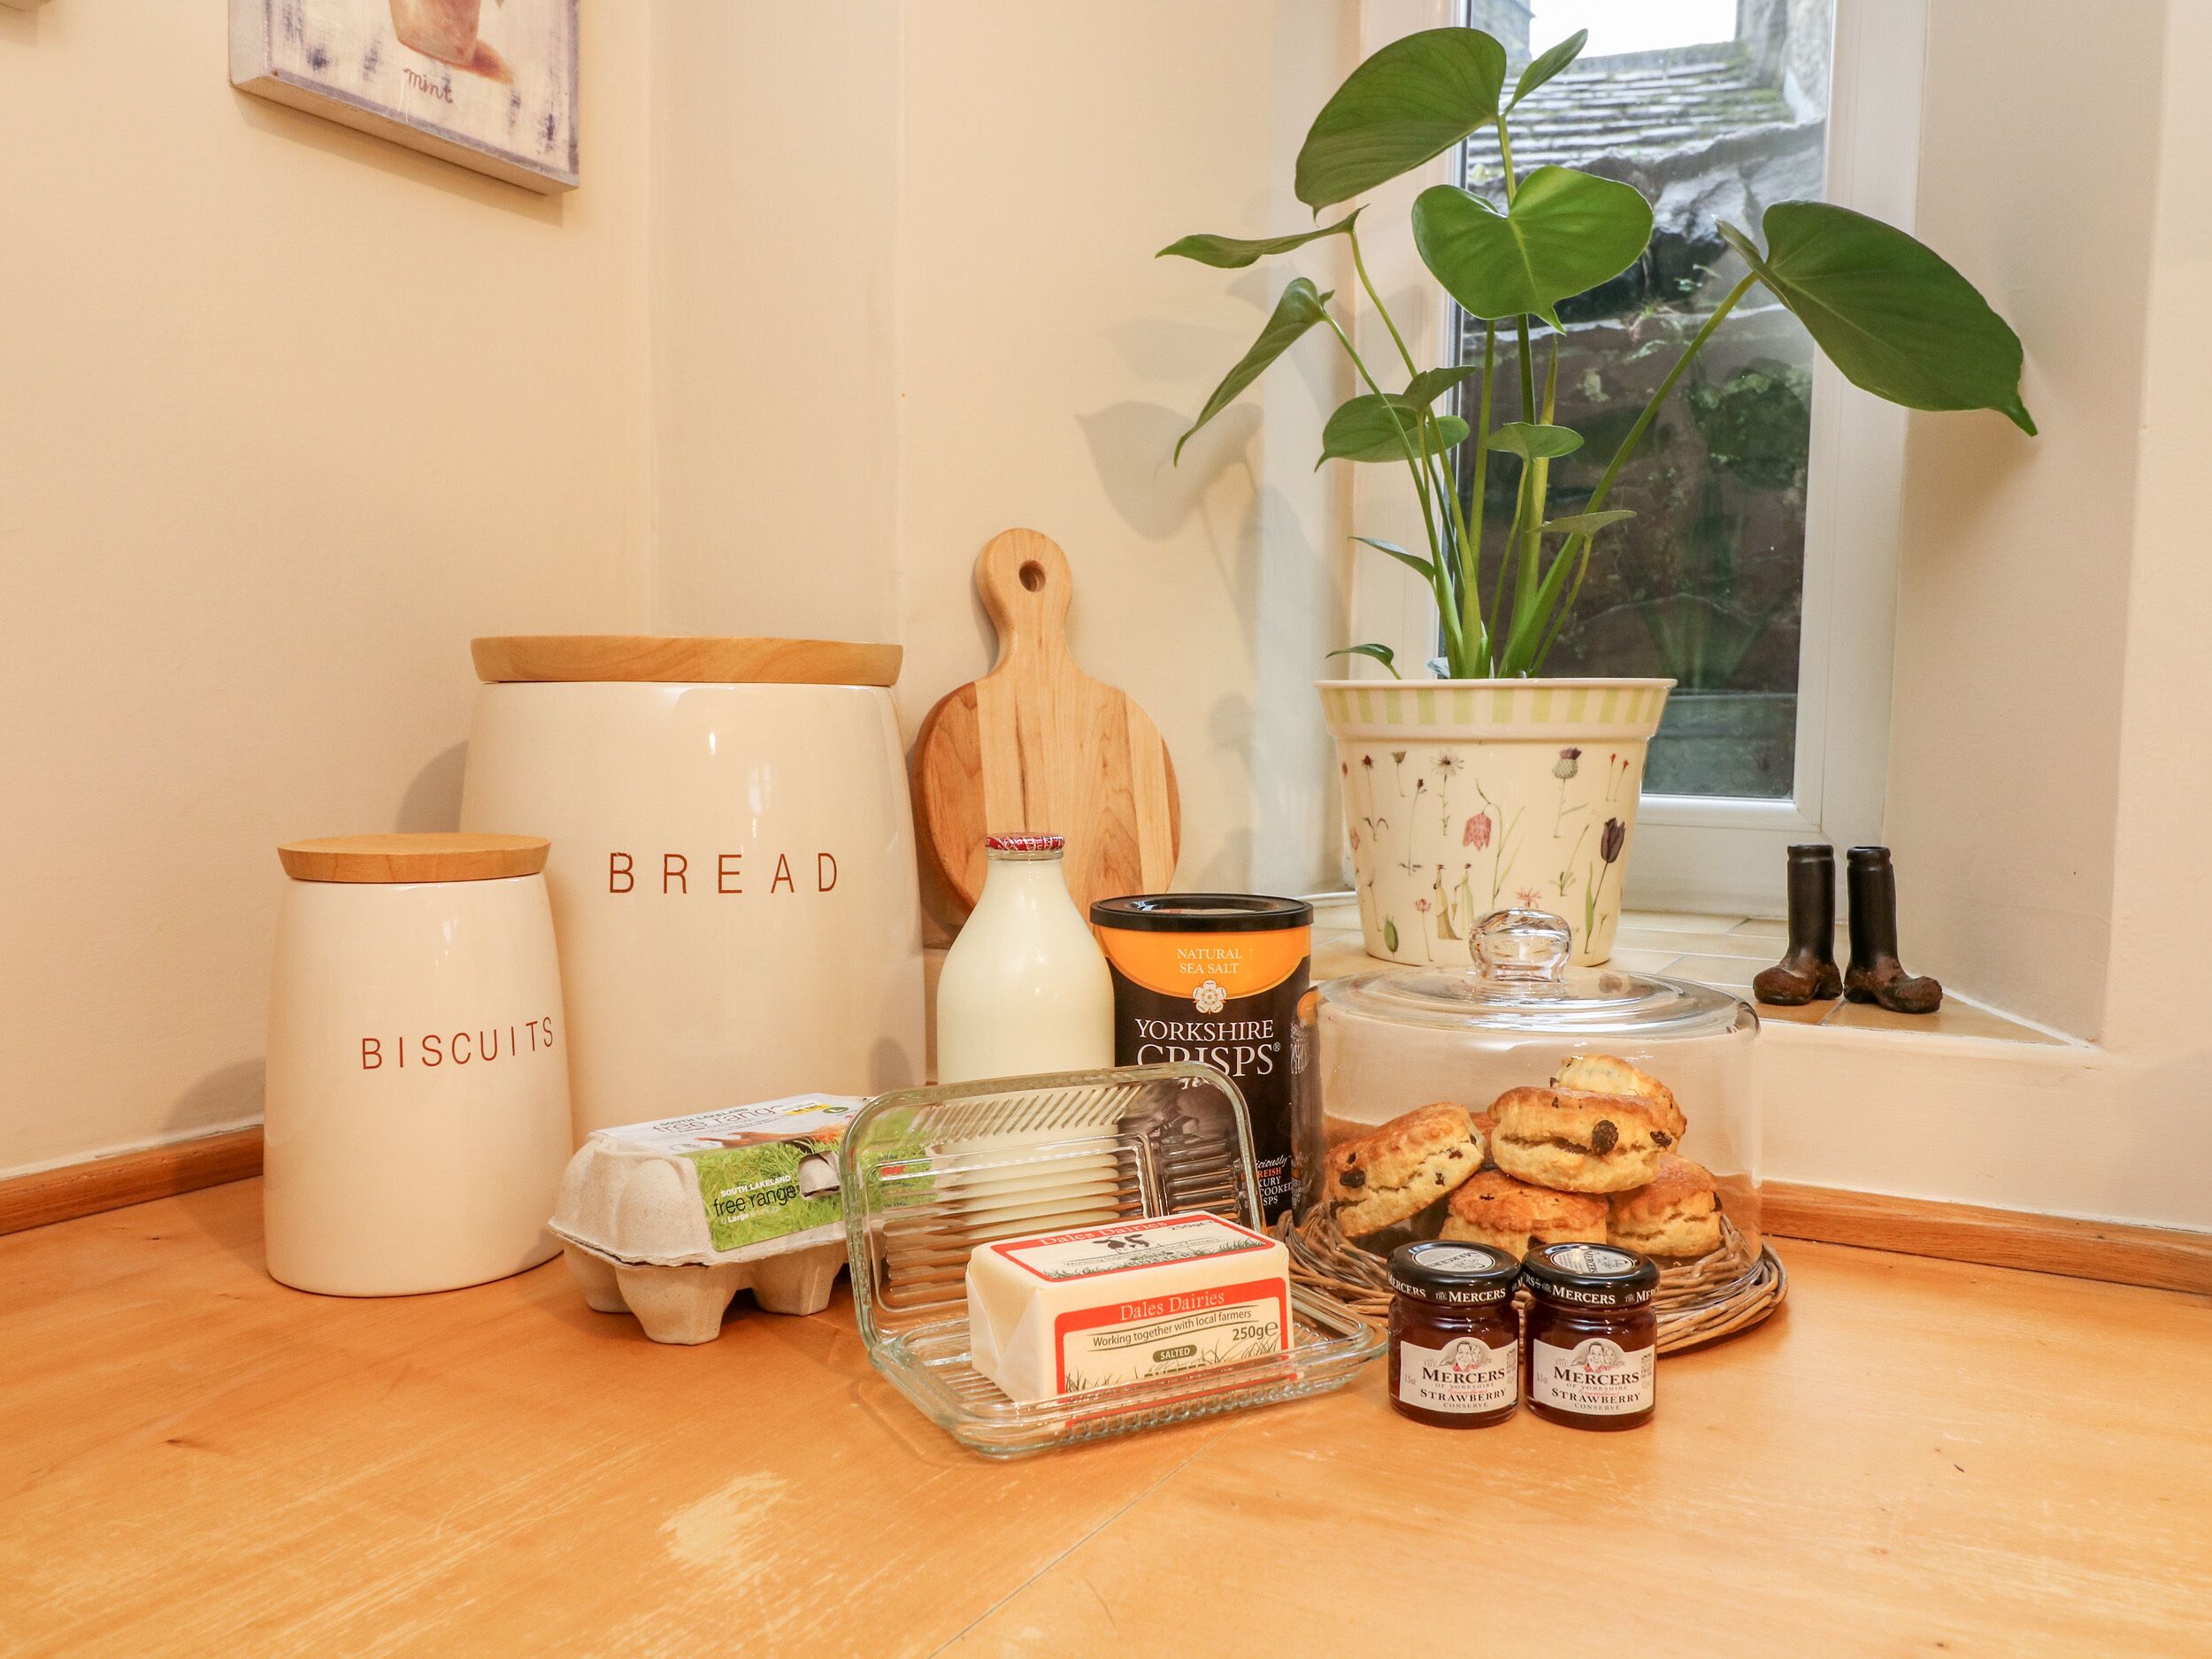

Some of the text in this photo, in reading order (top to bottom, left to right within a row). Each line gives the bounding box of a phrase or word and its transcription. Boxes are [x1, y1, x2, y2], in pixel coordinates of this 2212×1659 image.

[403, 68, 453, 104] mint
[609, 852, 838, 894] BREAD
[1176, 948, 1241, 960] NATURAL
[1179, 963, 1240, 974] SEA SALT
[1135, 1018, 1274, 1042] YORKSHIRE
[362, 1017, 554, 1070] BISCUITS
[696, 1108, 749, 1120] LAKELAND
[653, 1121, 707, 1133] free
[1256, 1155, 1287, 1168] iciously
[1257, 1167, 1282, 1179] REISH
[720, 1175, 791, 1197] SOUTH LAKELAND
[713, 1197, 746, 1217] free
[748, 1185, 796, 1209] range
[1263, 1194, 1279, 1206] SPS
[727, 1212, 749, 1224] Large
[1041, 1221, 1168, 1246] Dales Dairies
[1448, 1287, 1506, 1302] MERCERS
[1552, 1284, 1616, 1305] MERCERS
[1120, 1292, 1225, 1321] Dales Dairies
[1093, 1309, 1252, 1348] Working together with local farmers
[1160, 1347, 1190, 1360] SALTED
[1422, 1367, 1505, 1384] MERCERS
[1554, 1366, 1640, 1386] MERCERS
[1419, 1387, 1507, 1402] STRAWBERRY
[1551, 1387, 1641, 1404] STRAWBERRY
